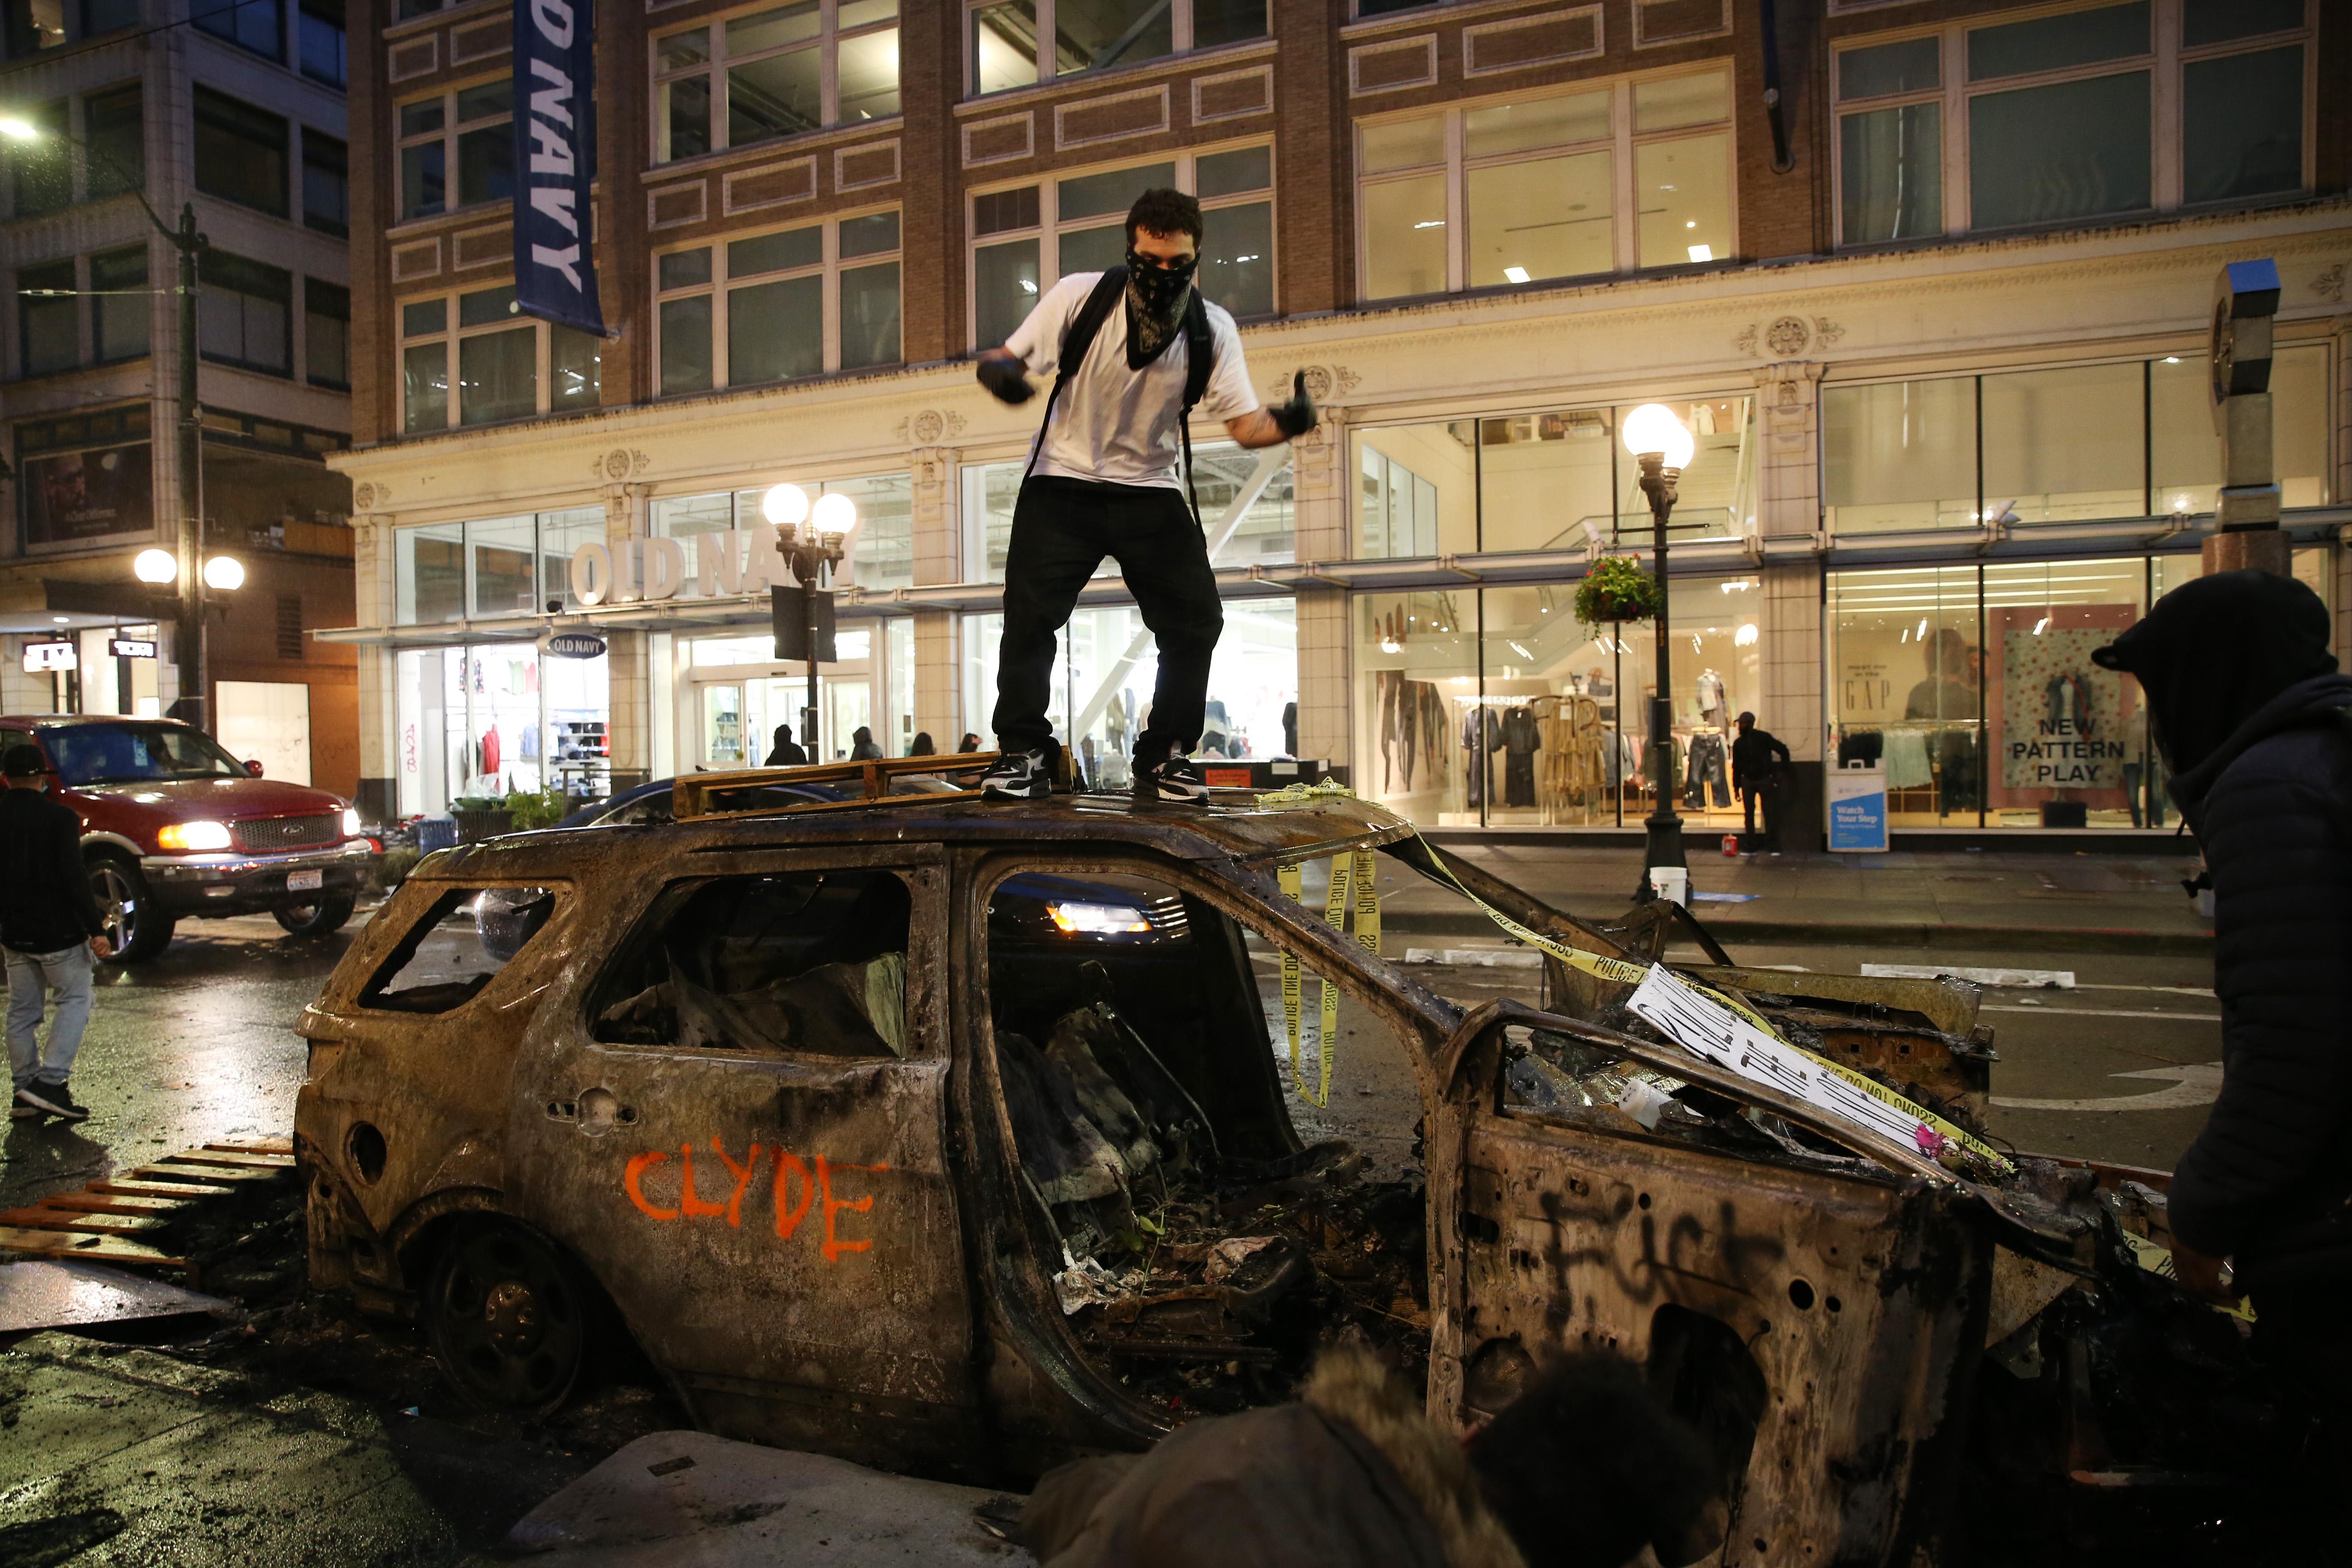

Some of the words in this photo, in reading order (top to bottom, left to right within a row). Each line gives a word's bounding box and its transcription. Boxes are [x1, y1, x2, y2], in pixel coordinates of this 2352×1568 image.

[529, 58, 583, 294] NAVY
[570, 537, 686, 605] OLD
[696, 518, 865, 597] NAY
[554, 638, 573, 652] OLD
[575, 639, 601, 654] NAVY
[1845, 680, 1890, 710] GAP
[2040, 719, 2096, 736] NEW
[2013, 741, 2126, 760] PATTERN
[2037, 765, 2101, 783] PLAY
[1836, 806, 1864, 814] Watch
[1836, 814, 1857, 823] Your
[1857, 814, 1878, 824] Step
[1593, 955, 1639, 982] POLICE
[1740, 1039, 1810, 1098] THE
[624, 1136, 889, 1262] CLYDE
